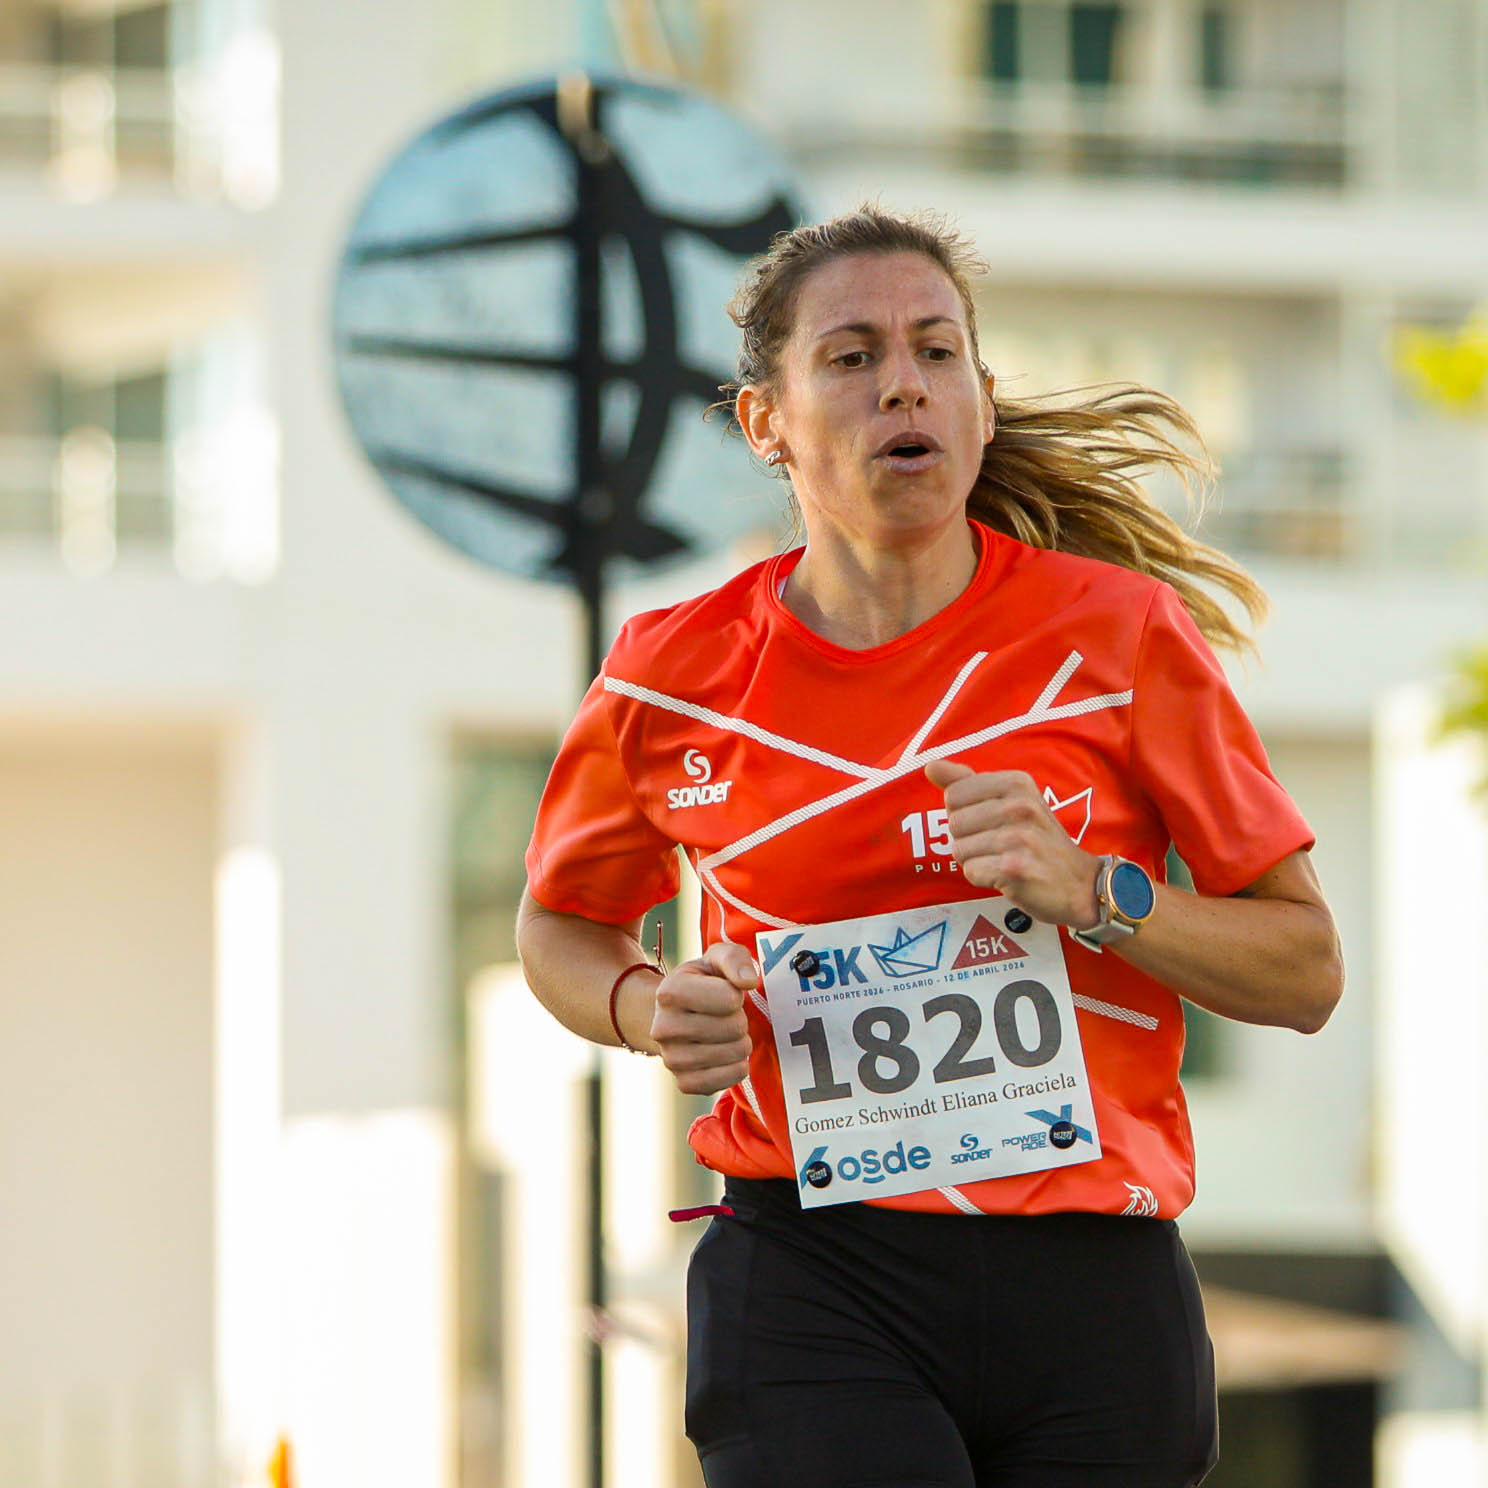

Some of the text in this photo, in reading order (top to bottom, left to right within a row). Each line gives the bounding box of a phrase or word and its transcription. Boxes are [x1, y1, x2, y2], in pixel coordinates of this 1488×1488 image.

[901, 809, 953, 859] 15
[915, 861, 958, 873] PUE
[966, 933, 1009, 959] 15K
[796, 994, 831, 1006] PUERTO
[833, 990, 861, 1000] NORTE
[863, 986, 884, 997] 2026
[894, 979, 933, 992] ROSARIO
[944, 974, 955, 984] 12
[958, 971, 969, 980] DE
[973, 967, 1000, 978] ABRIL
[1003, 962, 1025, 972] 2026
[790, 979, 1062, 1105] 1820
[795, 1073, 1077, 1134] Gomez Schwindt Eliana Graciela
[1001, 1131, 1047, 1147] POWER
[837, 1141, 932, 1181] osde
